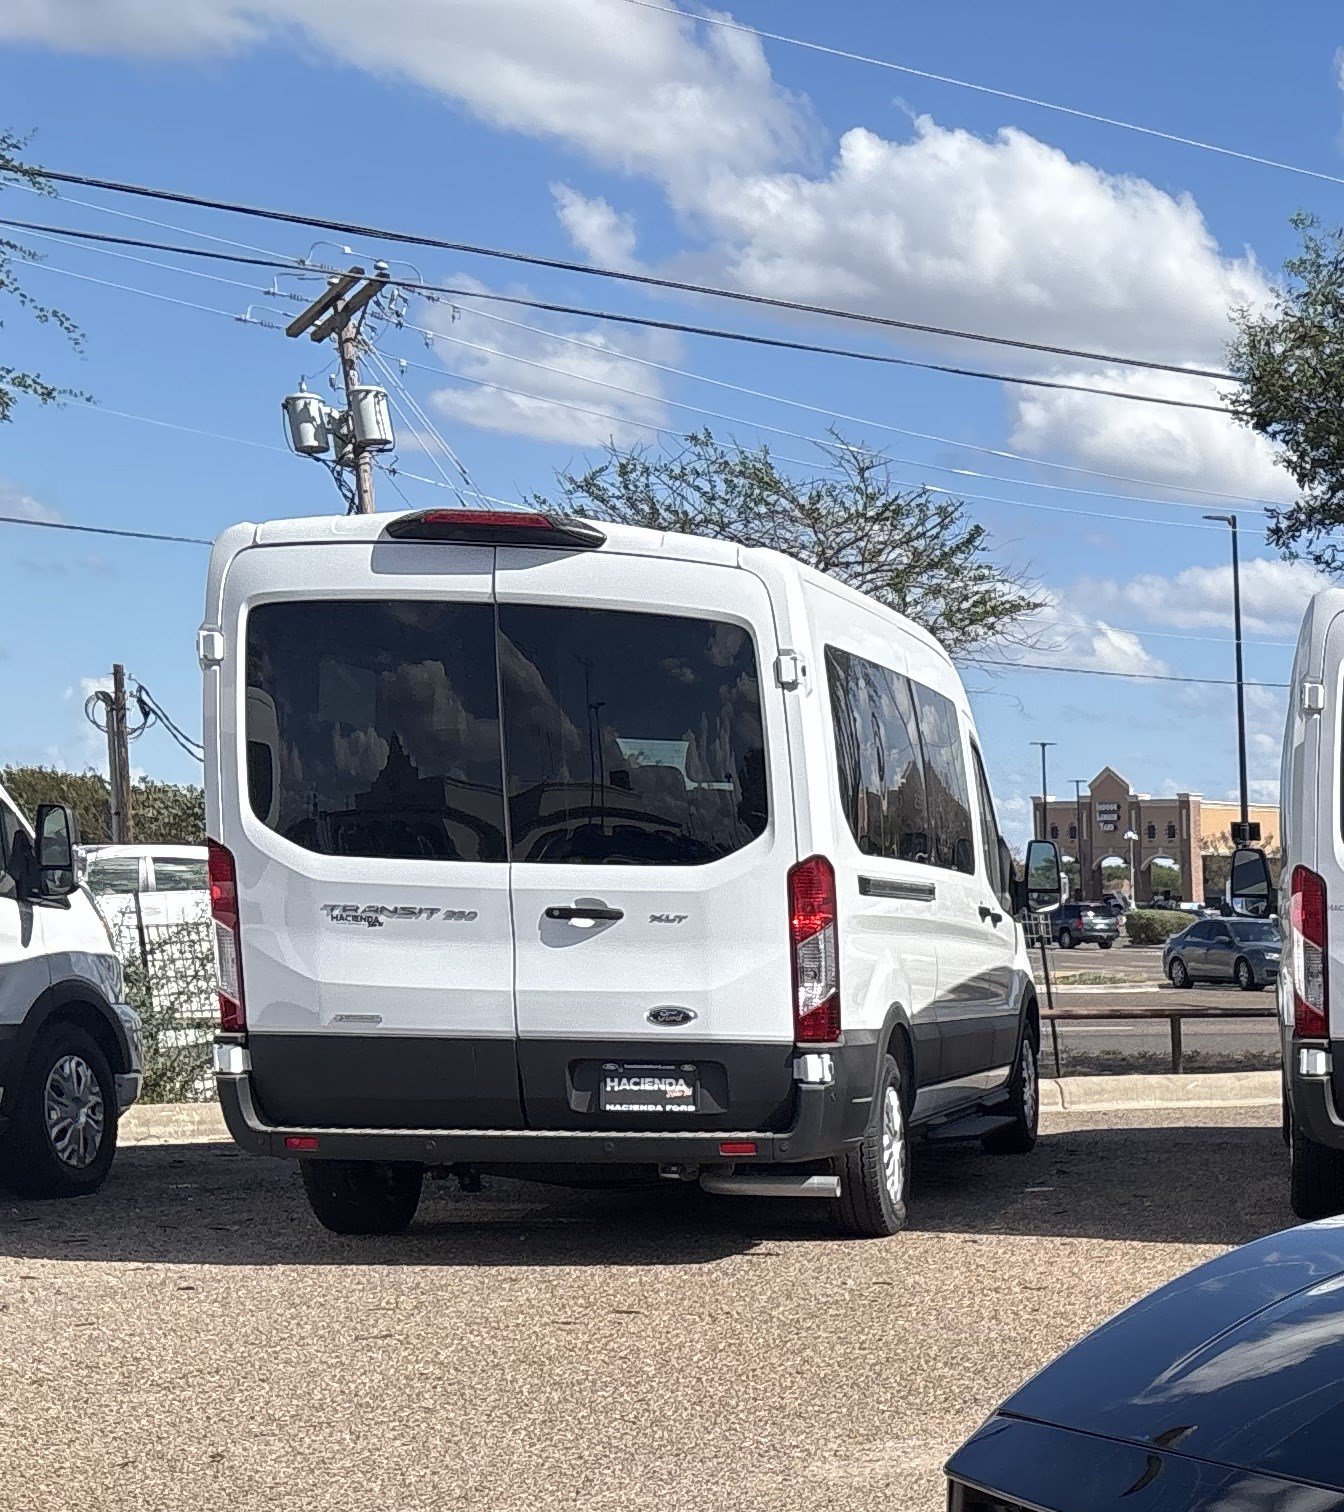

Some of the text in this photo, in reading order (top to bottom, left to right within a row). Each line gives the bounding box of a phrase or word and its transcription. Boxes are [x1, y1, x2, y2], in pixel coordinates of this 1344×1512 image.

[320, 903, 441, 921] TRANSIT
[605, 1077, 688, 1092] HACIENDA
[605, 1103, 696, 1112] HACIENDA FORD
